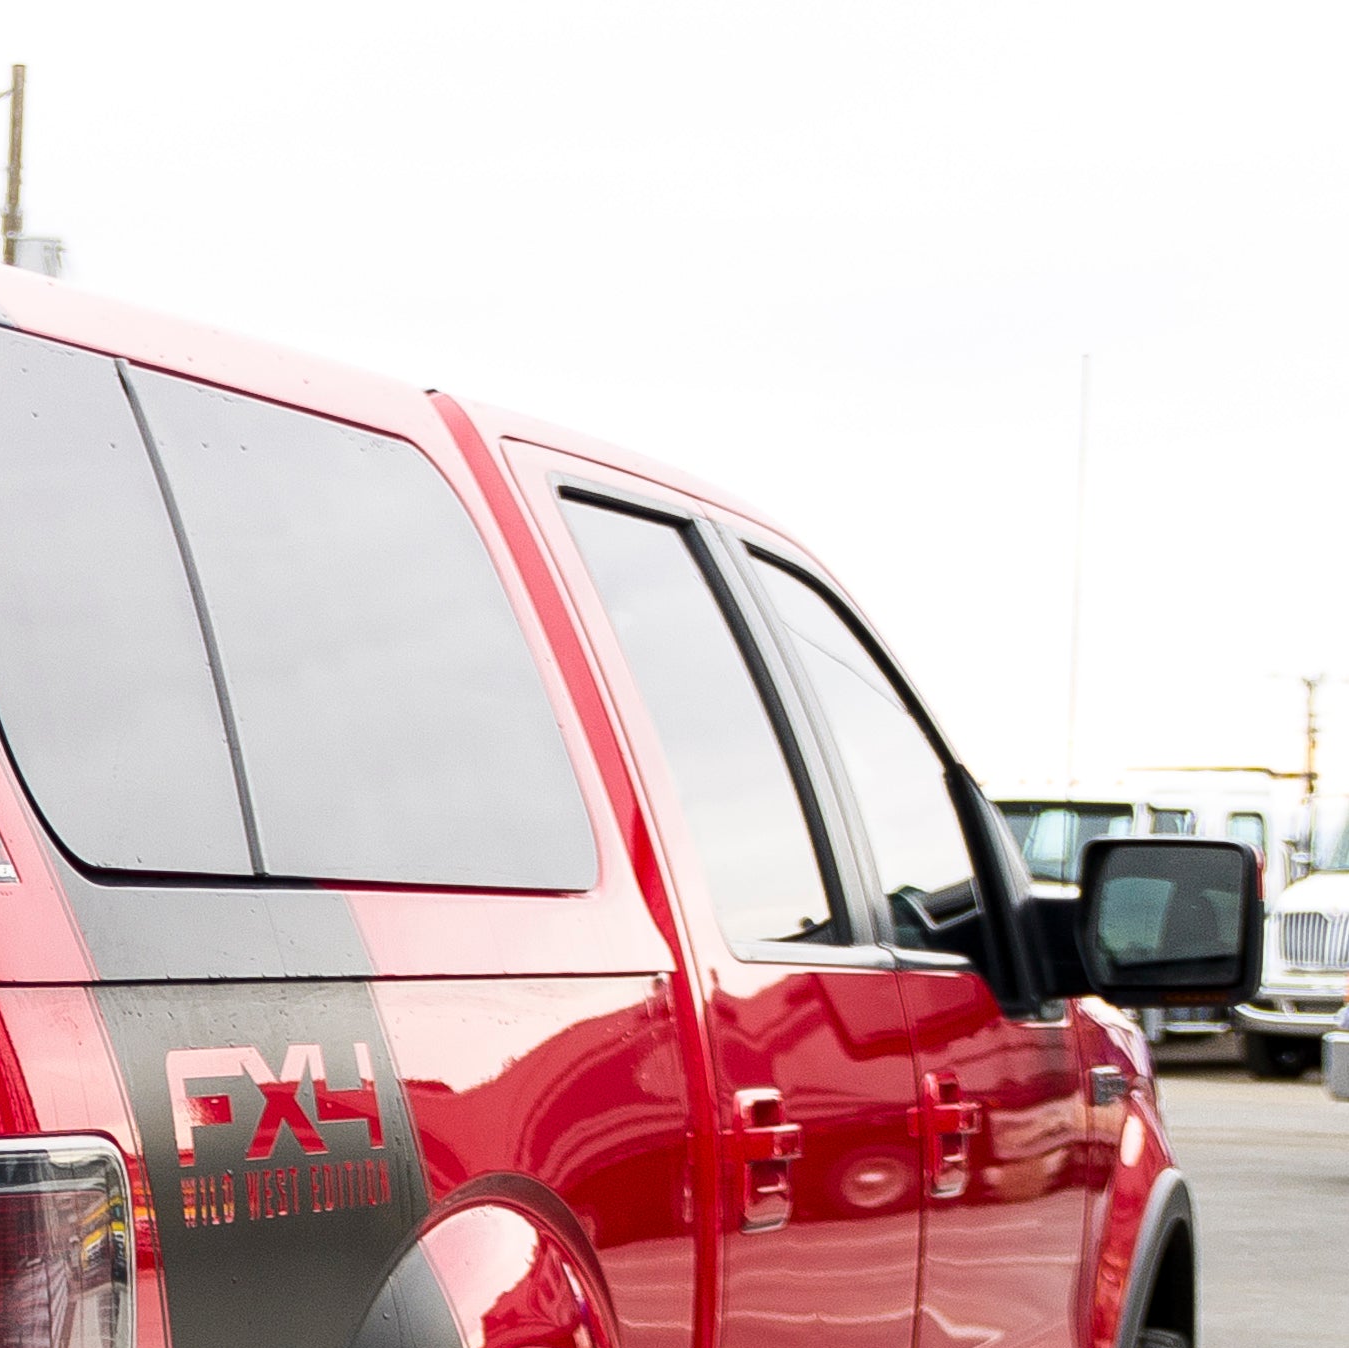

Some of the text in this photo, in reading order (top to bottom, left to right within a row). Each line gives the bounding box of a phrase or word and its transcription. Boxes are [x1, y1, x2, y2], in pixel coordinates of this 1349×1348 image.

[166, 1042, 384, 1167] FX4
[245, 1166, 301, 1220] WEST
[309, 1158, 392, 1213] EDITION
